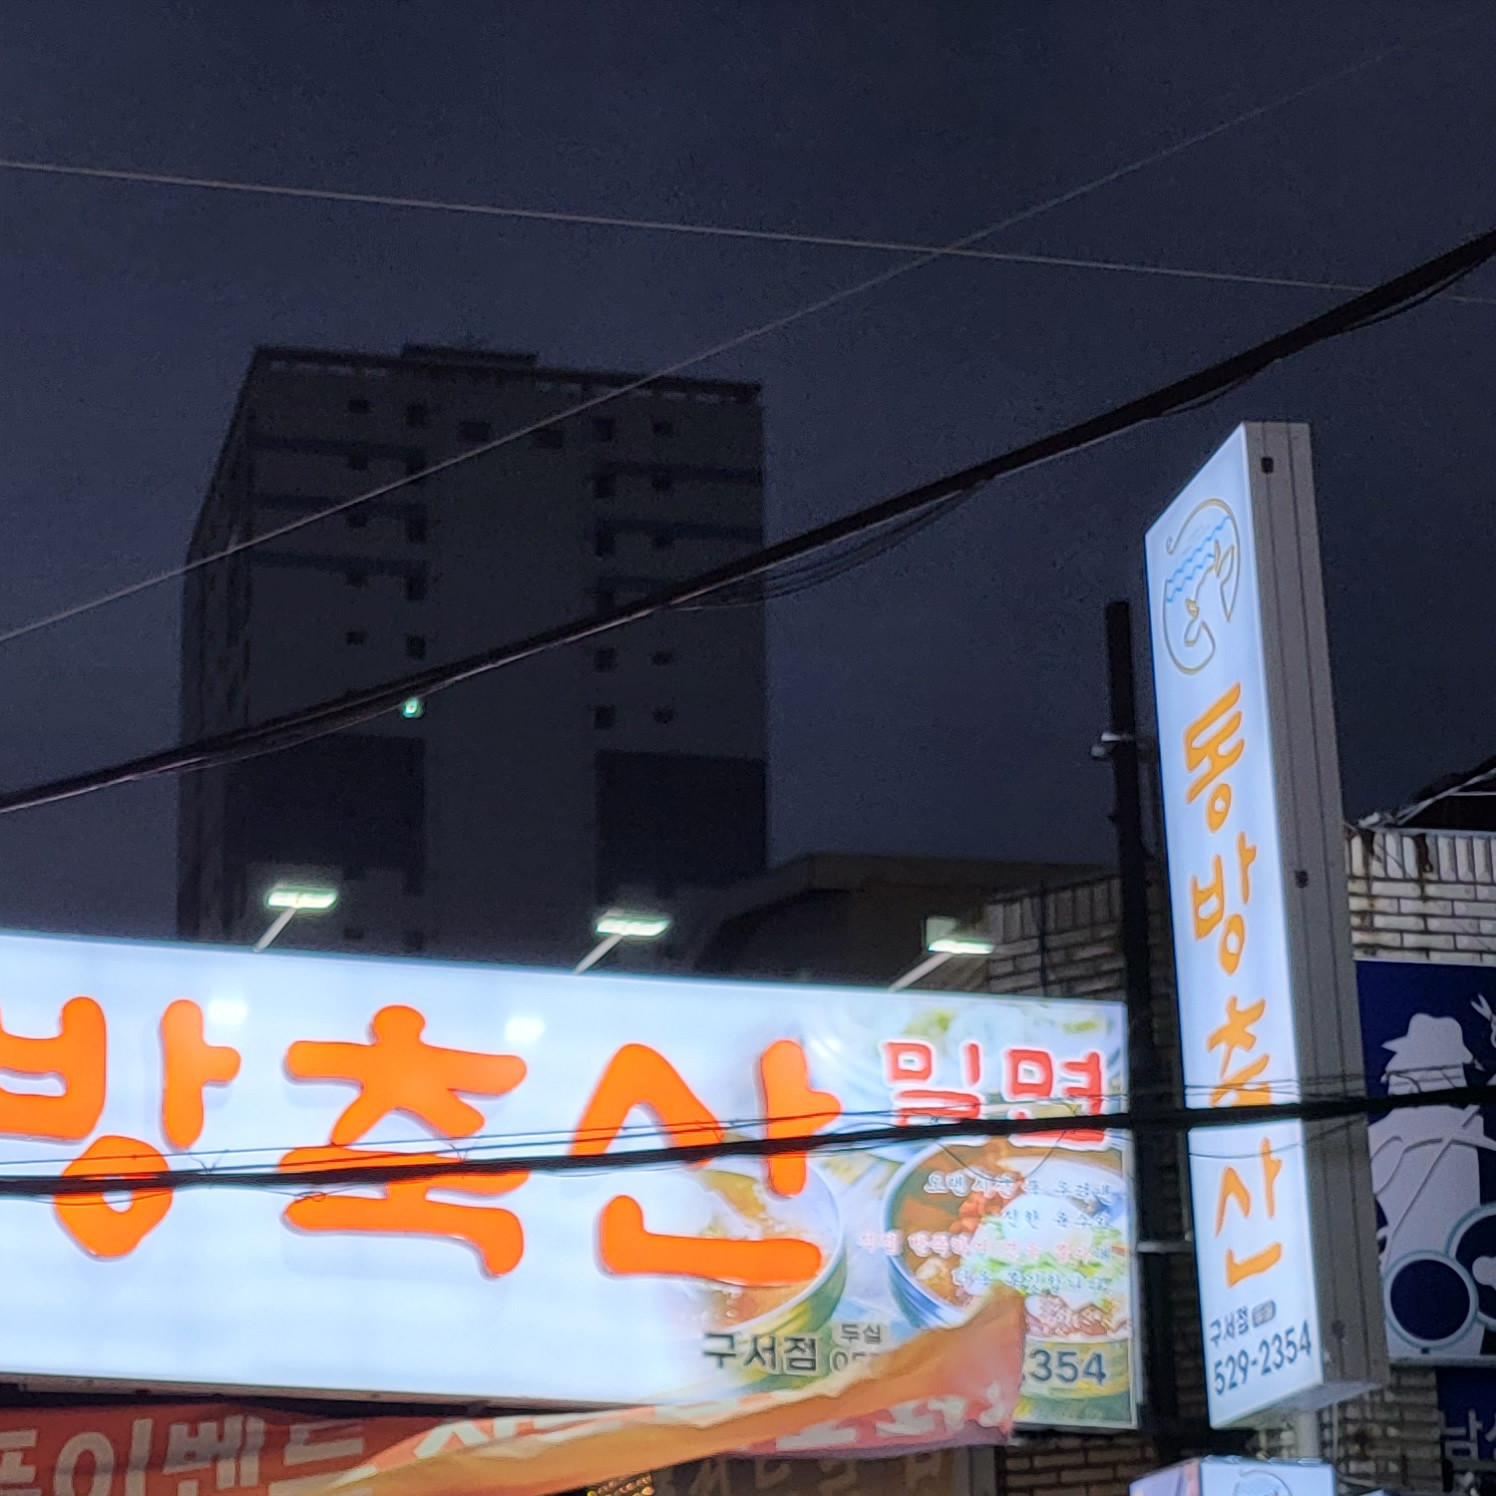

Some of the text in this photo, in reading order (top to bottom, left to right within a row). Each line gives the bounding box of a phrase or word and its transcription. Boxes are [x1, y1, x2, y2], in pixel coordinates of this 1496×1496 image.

[1184, 681, 1283, 1288] 동방축산
[882, 1040, 1106, 1144] 밀면
[703, 1331, 818, 1375] 구서점
[1023, 1347, 1107, 1385] 354
[1213, 1318, 1312, 1396] 529-2354
